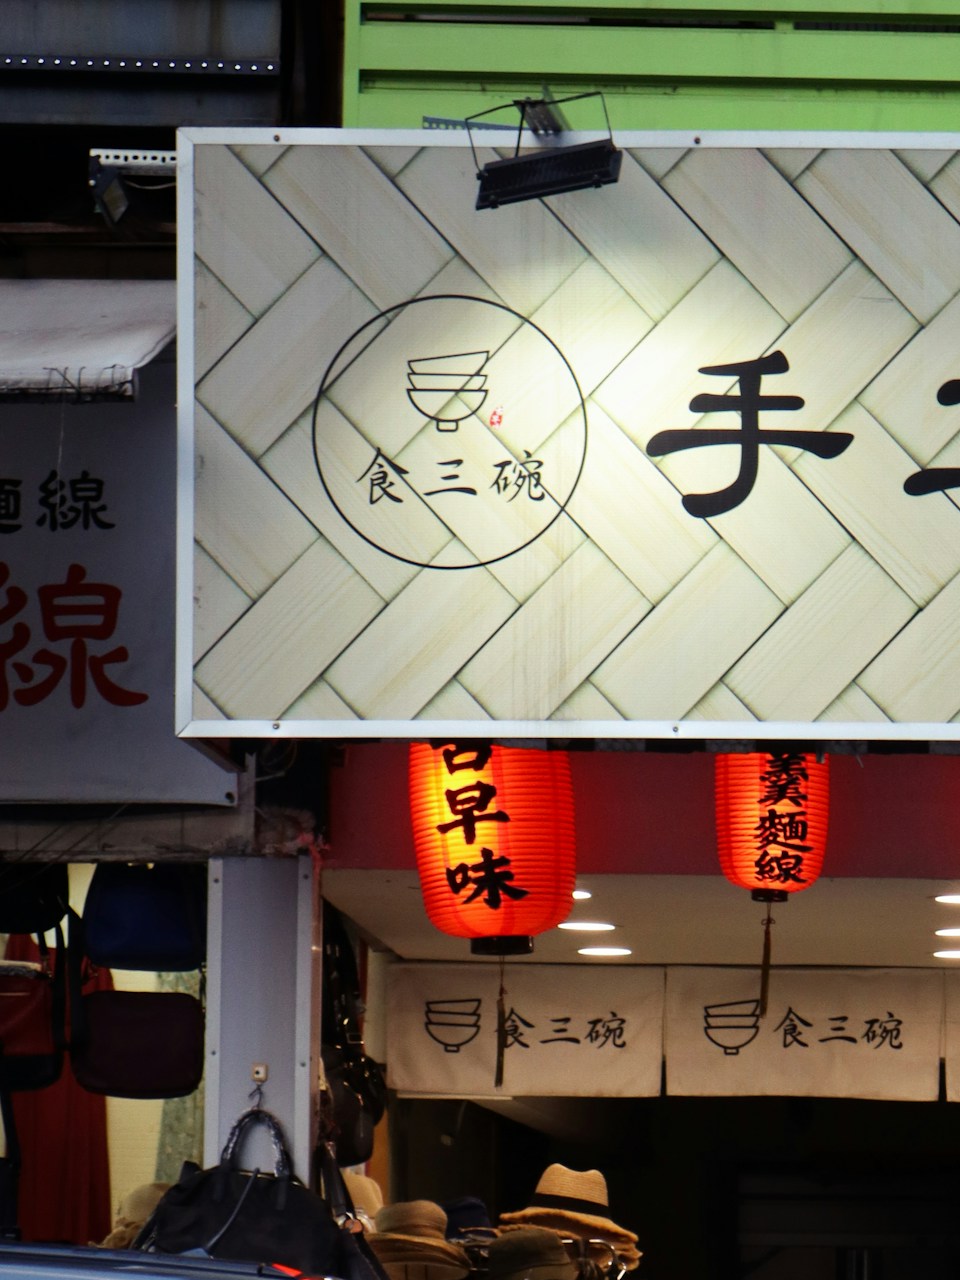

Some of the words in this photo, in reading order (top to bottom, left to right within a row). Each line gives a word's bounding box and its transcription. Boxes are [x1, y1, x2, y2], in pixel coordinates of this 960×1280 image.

[355, 446, 546, 505] 食三碗
[0, 469, 117, 534] 線
[496, 1007, 628, 1050] 食三碗
[773, 1006, 904, 1050] 食三碗
